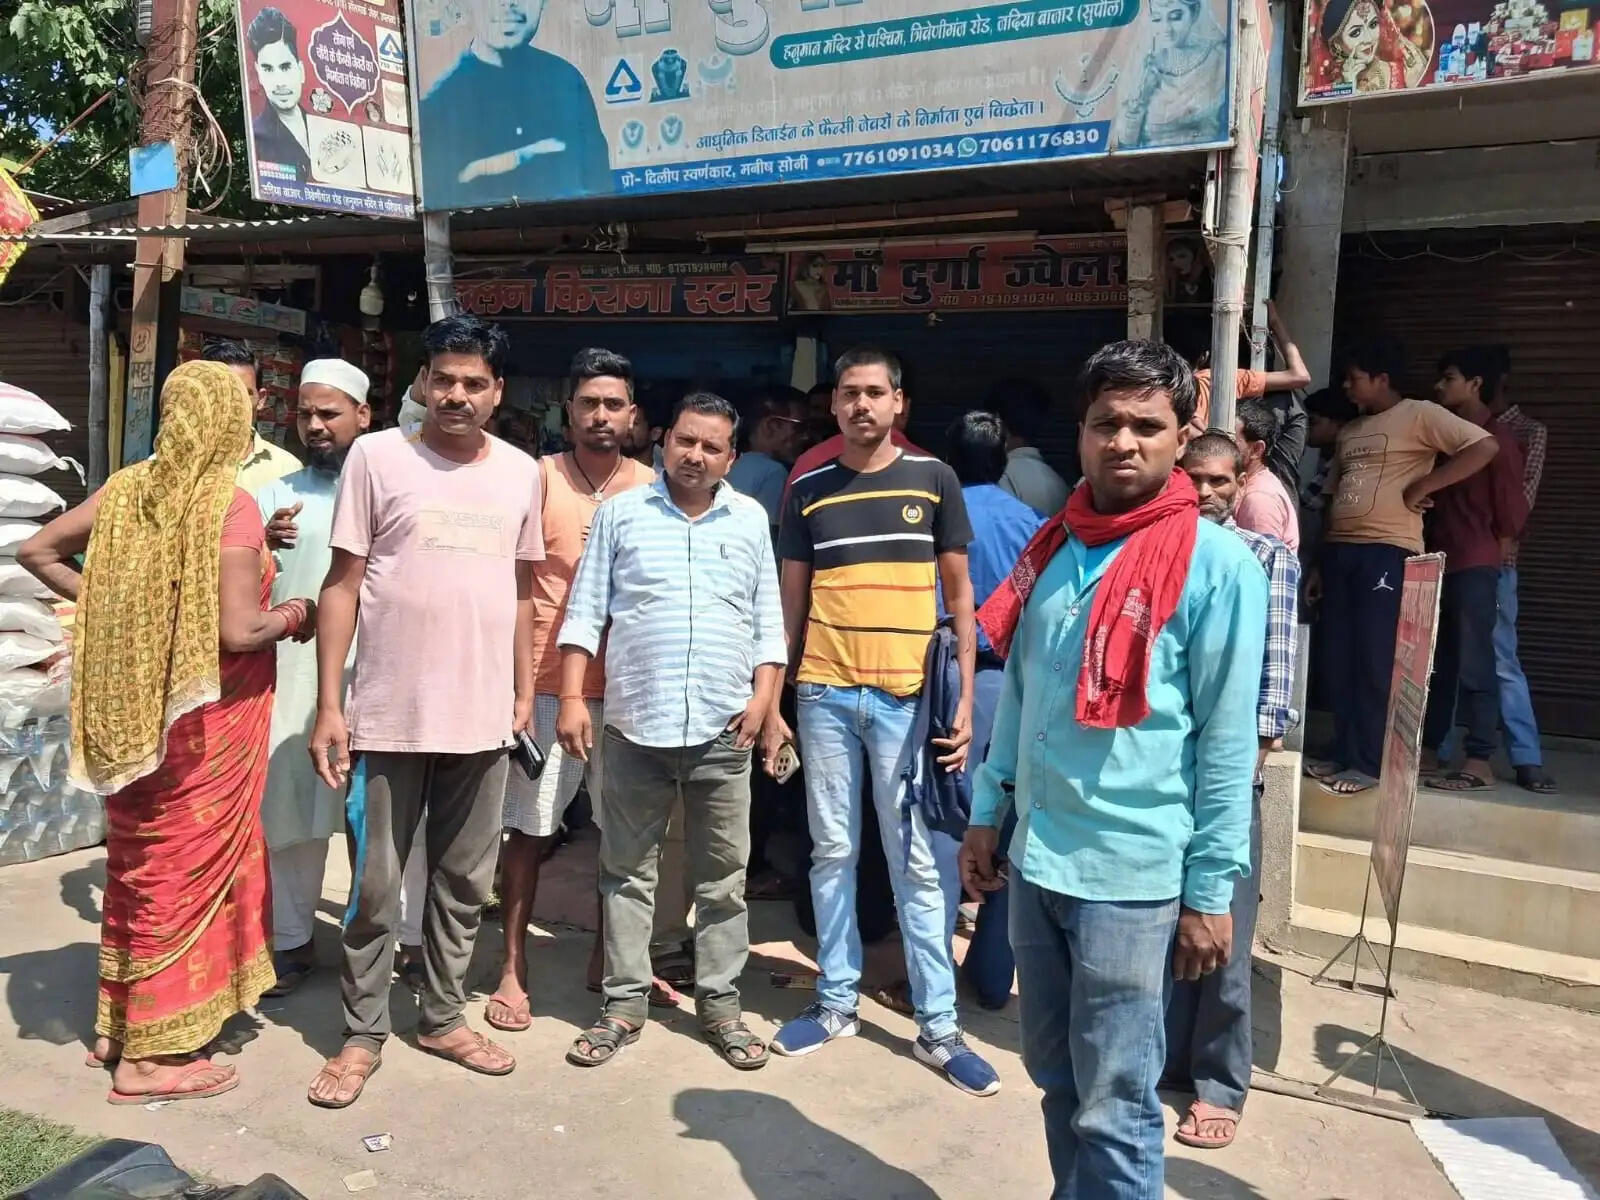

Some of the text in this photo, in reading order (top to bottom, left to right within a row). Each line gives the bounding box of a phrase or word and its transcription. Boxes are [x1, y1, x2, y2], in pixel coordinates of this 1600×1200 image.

[783, 41, 822, 64] हनुमान
[823, 32, 853, 54] मंदिर
[854, 29, 865, 50] से
[867, 27, 906, 48] पश्चिम,
[909, 18, 967, 44] त्रिवेणीगंज
[970, 14, 993, 36] रोड,
[997, 8, 1034, 31] जदिया
[1037, 5, 1074, 26] बाजार
[696, 128, 748, 152] आधुनिक
[752, 121, 798, 143] डिजाईन
[801, 120, 814, 138] के
[818, 112, 854, 137] फैन्सी
[858, 111, 892, 132] जेवरों
[897, 110, 911, 128] के
[915, 107, 959, 127] निर्माता
[963, 102, 984, 127] एवं
[989, 98, 1035, 118] विक्रेता
[645, 167, 680, 185] दिलीप
[683, 162, 737, 183] स्वर्णकार,
[740, 158, 774, 176] मनीष
[777, 154, 809, 173] सोनी
[842, 142, 955, 167] 7761091034
[980, 127, 1100, 153] 7061176830
[544, 263, 677, 314] किराना
[682, 261, 778, 314] स्टोर
[901, 244, 988, 305] दुर्गा
